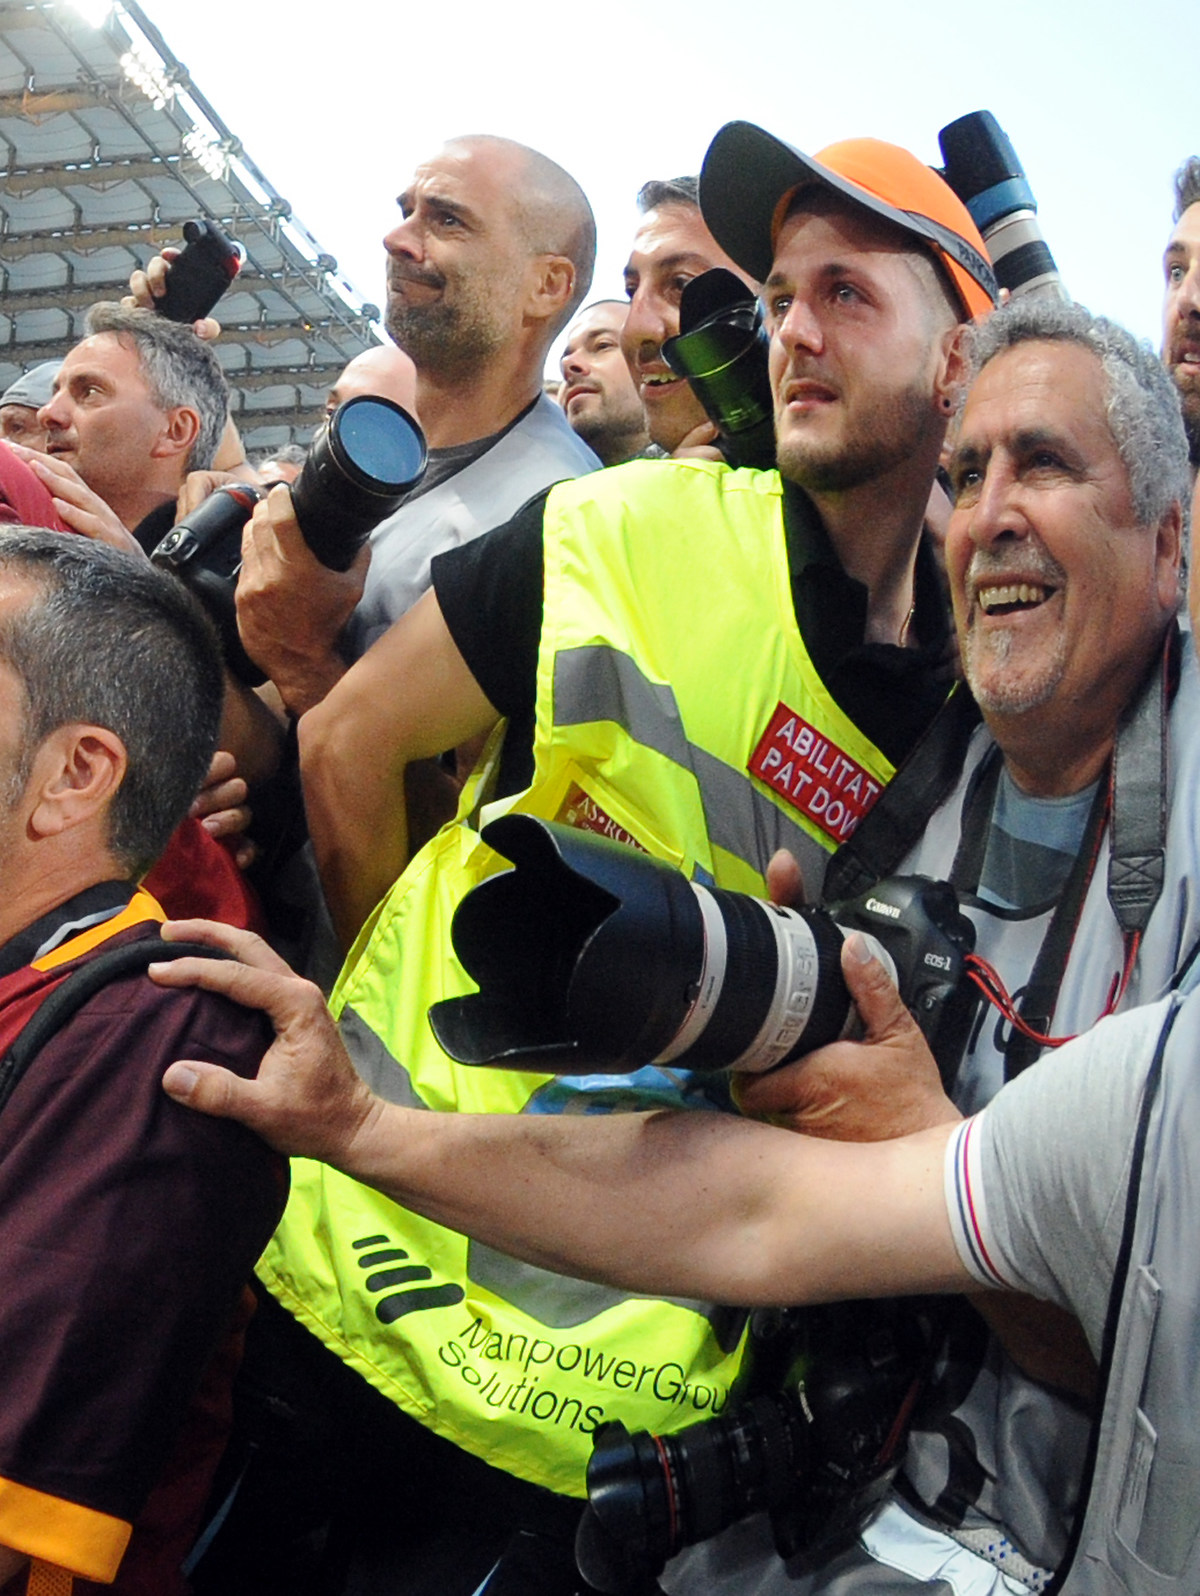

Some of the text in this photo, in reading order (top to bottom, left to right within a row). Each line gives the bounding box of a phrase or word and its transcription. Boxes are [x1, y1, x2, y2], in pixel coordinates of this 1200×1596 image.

[760, 747, 860, 836] PAT DOW
[776, 717, 880, 807] ABILITAT
[865, 898, 901, 919] Canon
[438, 1341, 604, 1433] Solutions
[459, 1317, 730, 1415] ManpowerGrou
